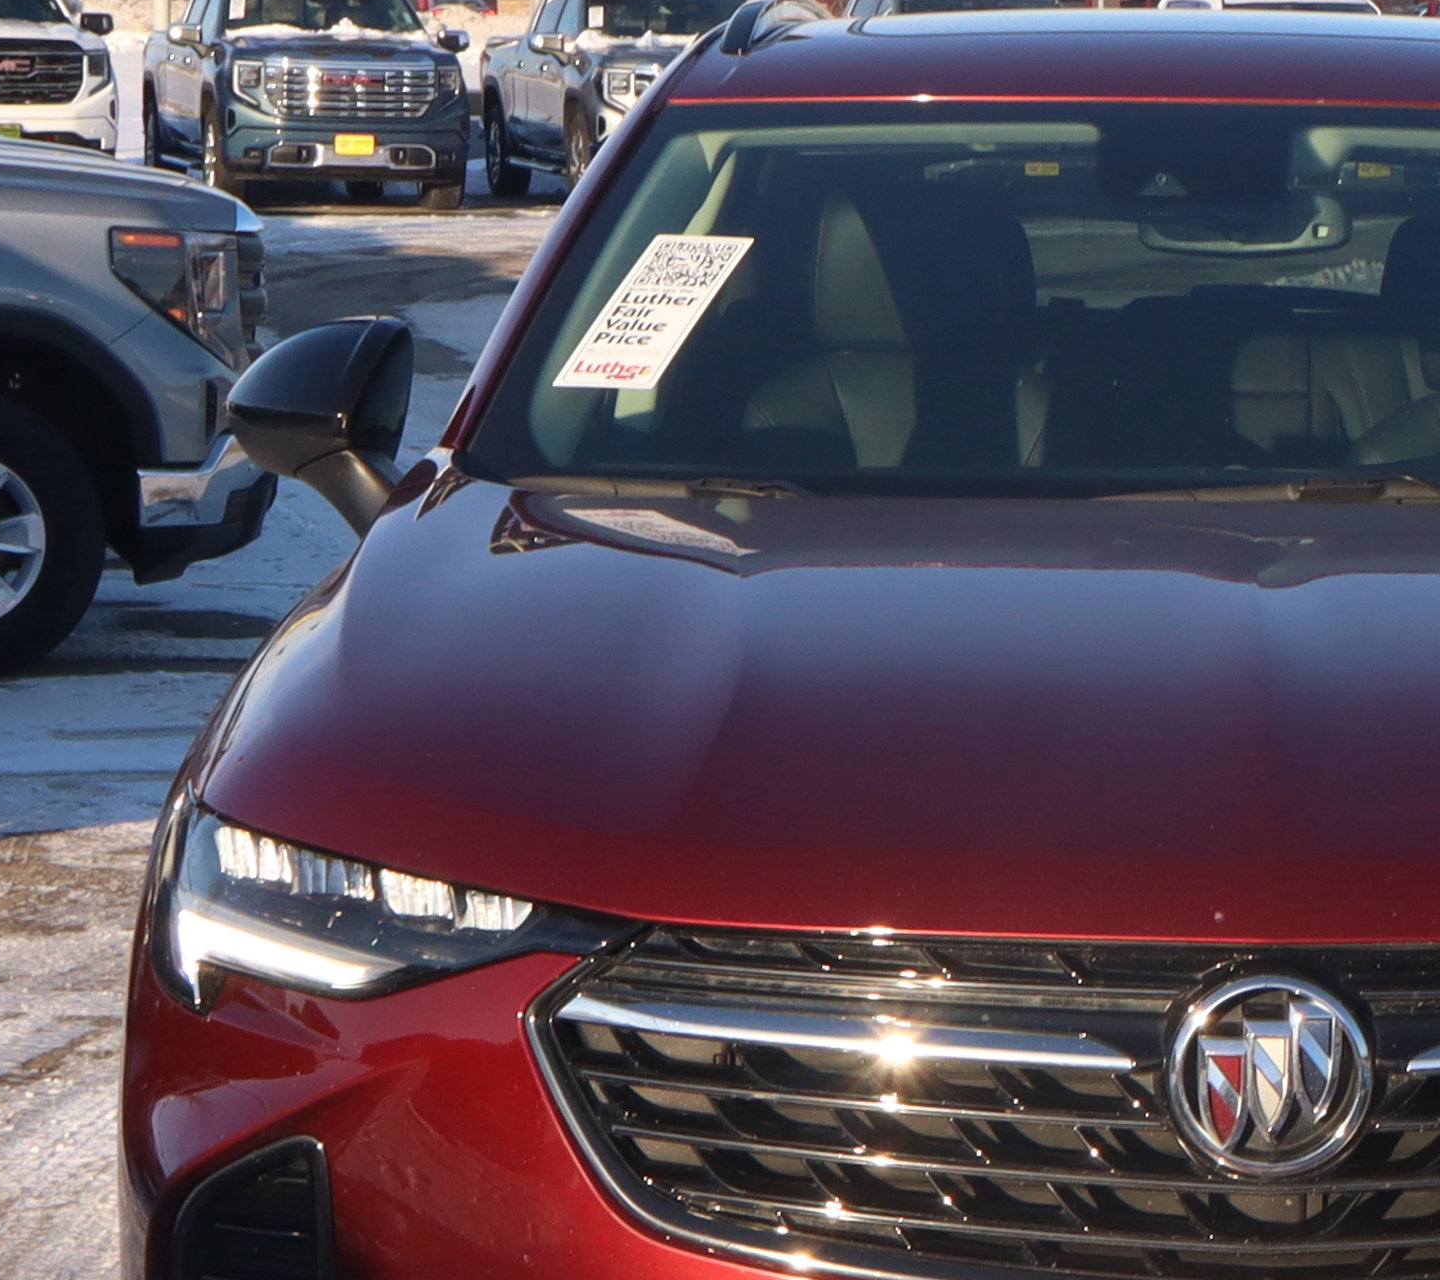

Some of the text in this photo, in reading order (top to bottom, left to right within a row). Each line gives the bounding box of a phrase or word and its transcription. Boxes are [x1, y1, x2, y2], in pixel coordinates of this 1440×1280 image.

[621, 292, 698, 306] Luther
[611, 305, 655, 318] Fair
[605, 318, 668, 332] Value
[593, 331, 652, 345] Price
[573, 360, 652, 376] Luther
